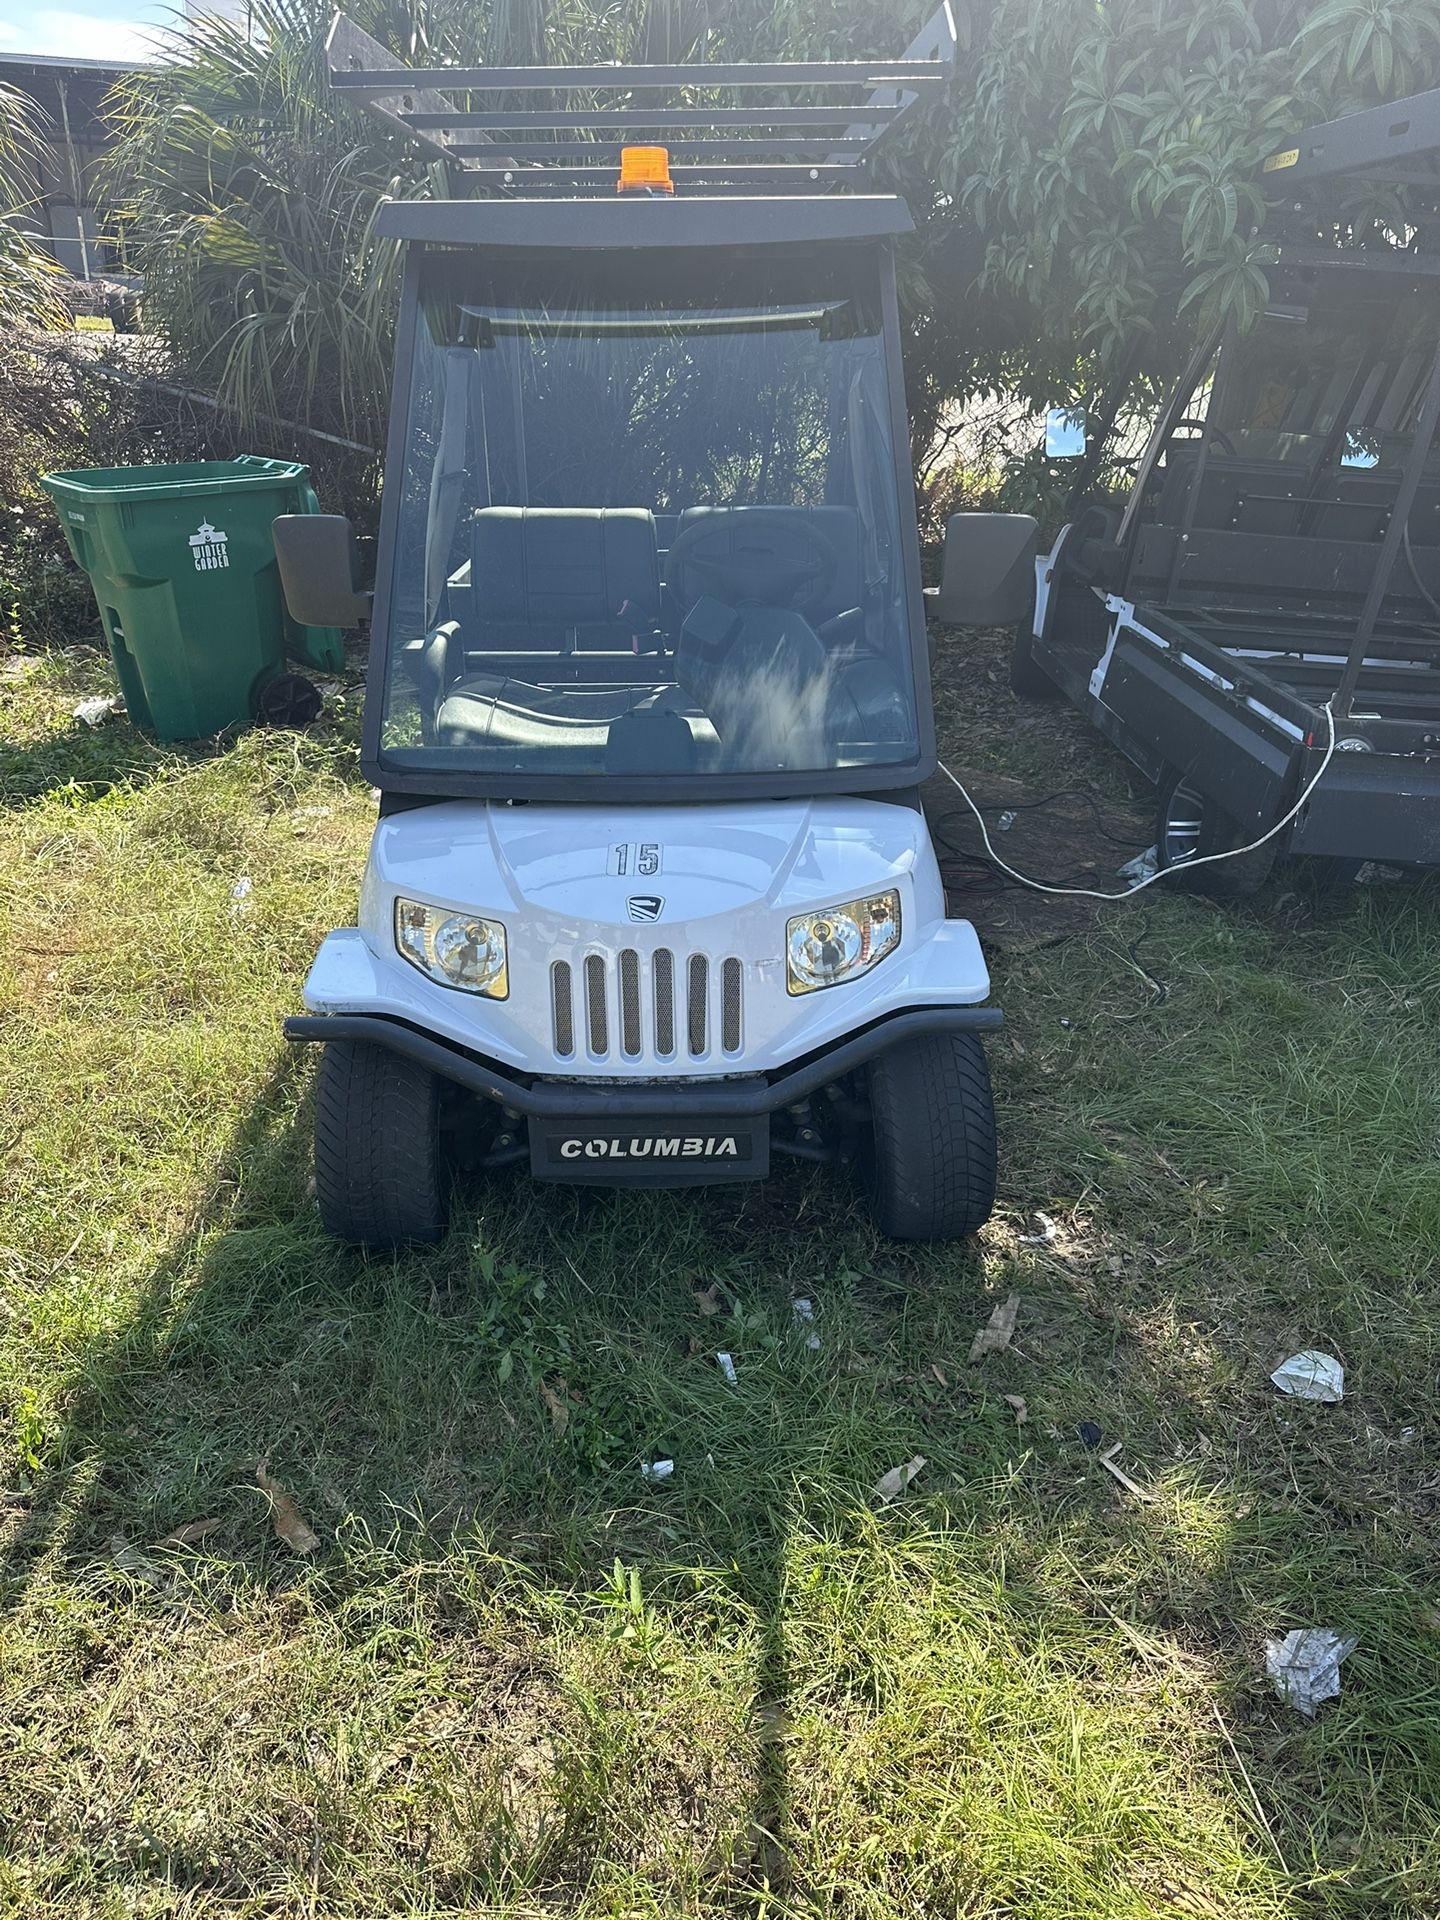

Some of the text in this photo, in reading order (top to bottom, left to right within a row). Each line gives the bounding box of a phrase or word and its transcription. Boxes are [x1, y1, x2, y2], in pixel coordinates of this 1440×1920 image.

[192, 543, 227, 559] WINTER
[195, 555, 230, 571] GARDEN
[615, 843, 659, 875] 15
[560, 1137, 738, 1158] COLUMBIA
